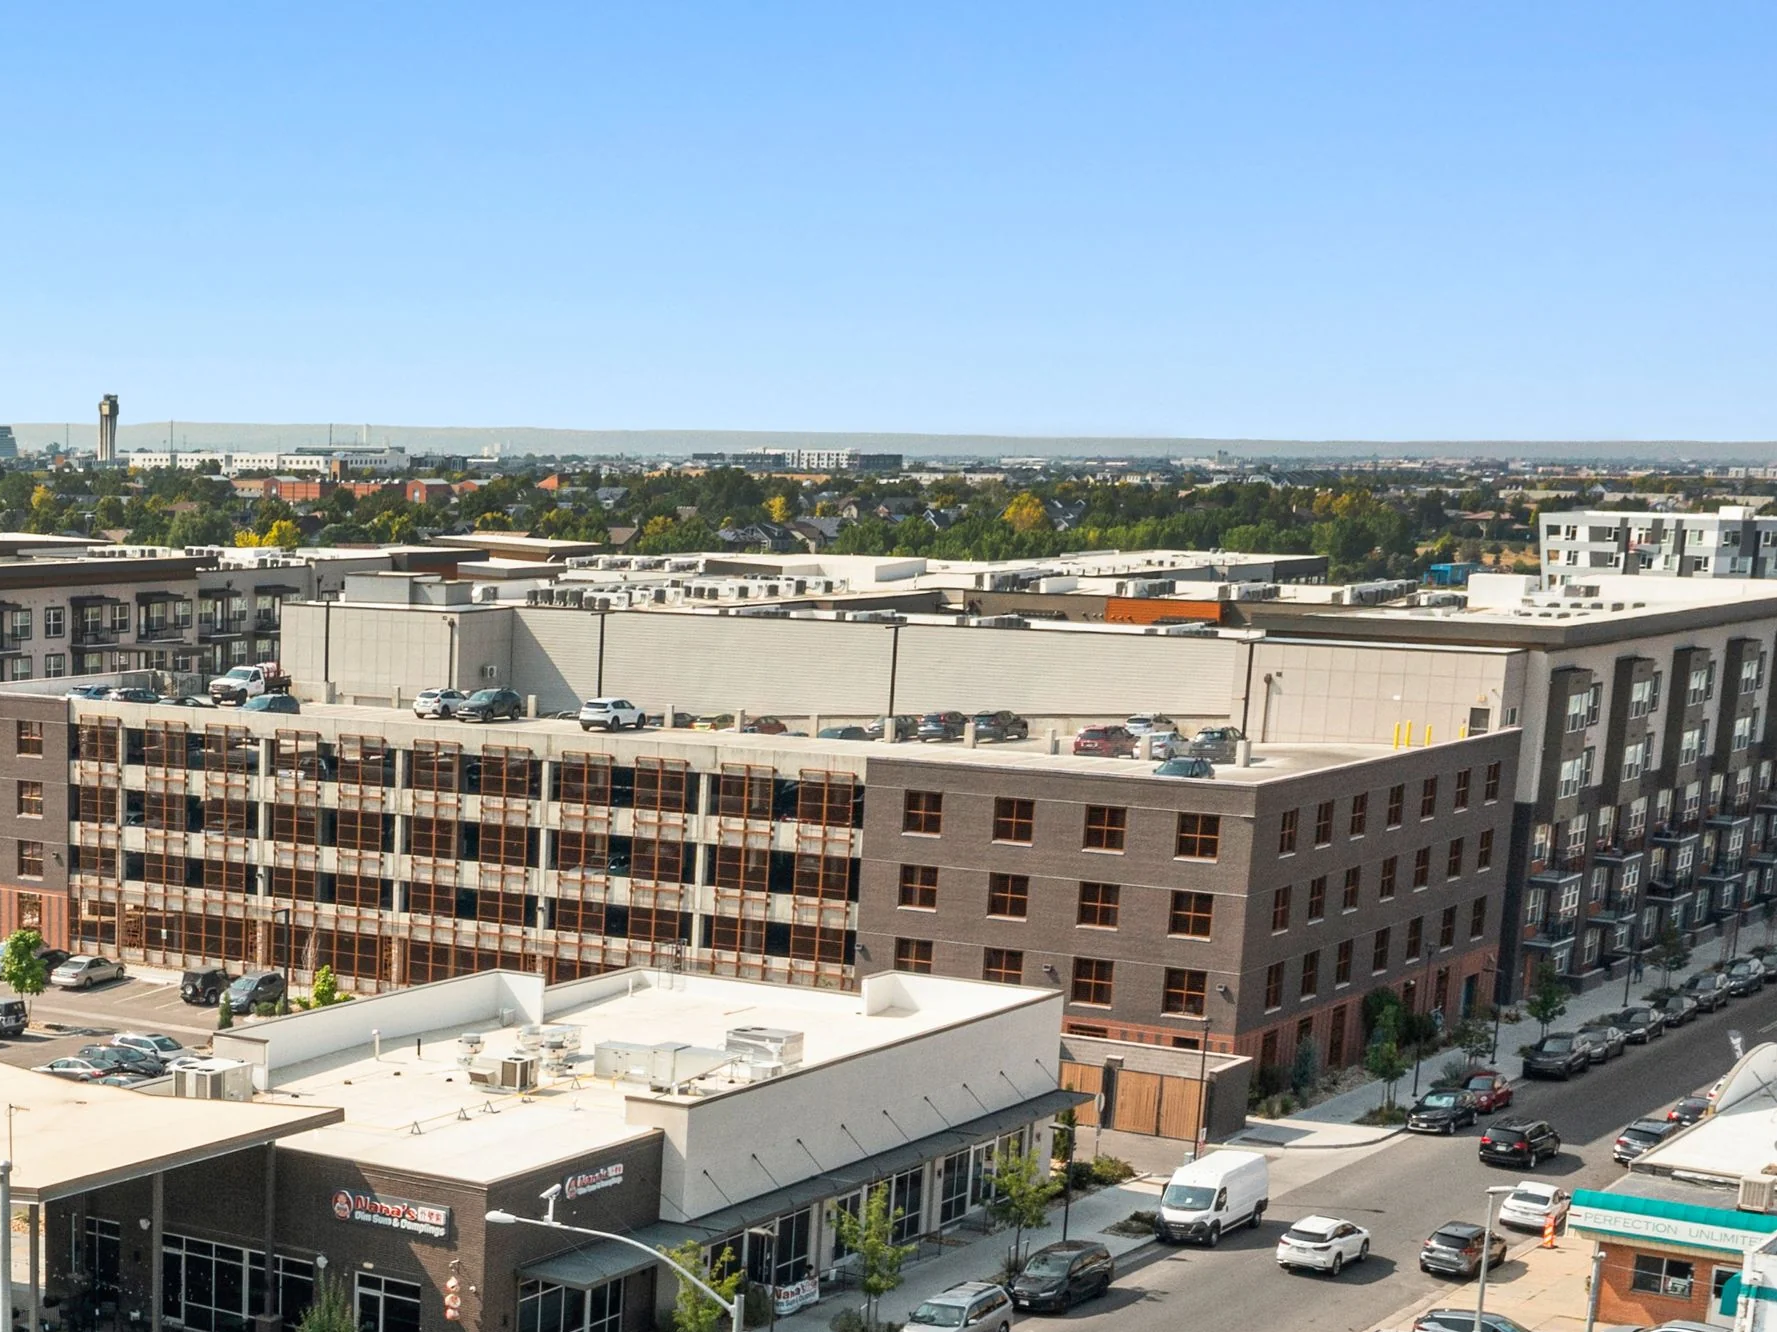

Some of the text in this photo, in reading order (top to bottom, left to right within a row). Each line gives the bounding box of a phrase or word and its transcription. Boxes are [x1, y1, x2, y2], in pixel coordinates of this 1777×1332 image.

[355, 1195, 418, 1220] Nana's
[355, 1210, 446, 1237] Dim Sum & Dumplings
[1584, 1212, 1764, 1247] PERFECTION UNLIMITE
